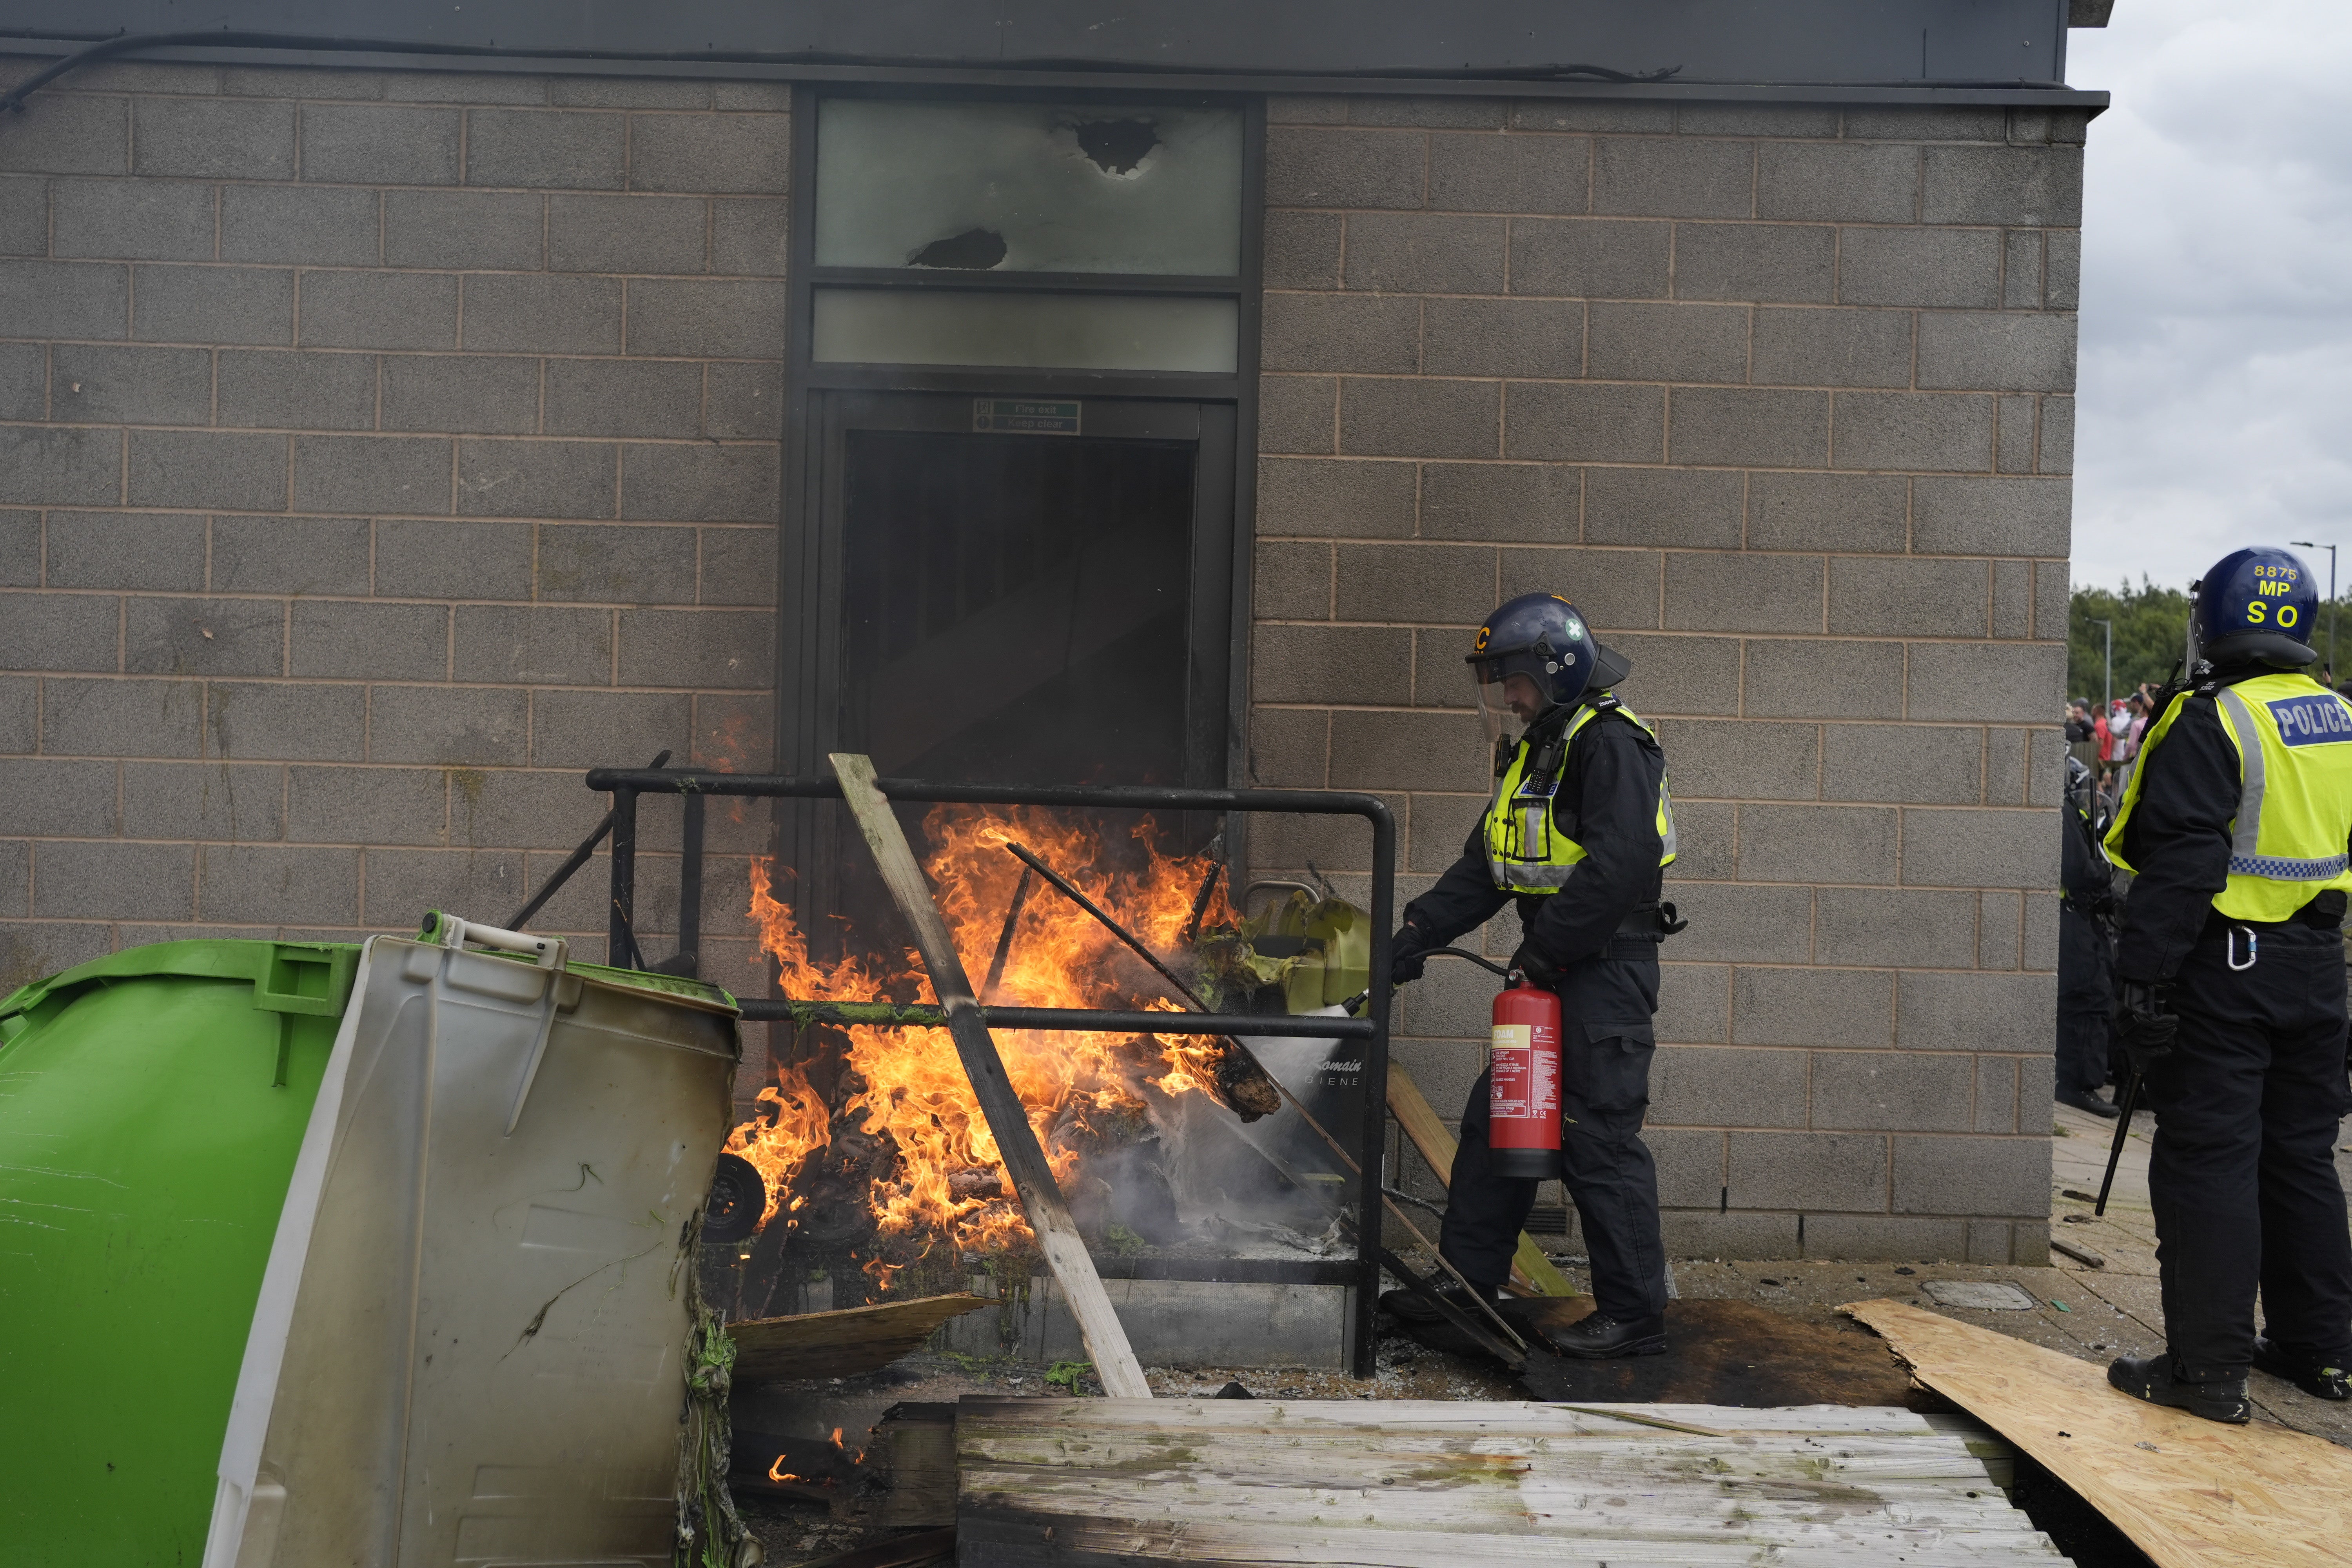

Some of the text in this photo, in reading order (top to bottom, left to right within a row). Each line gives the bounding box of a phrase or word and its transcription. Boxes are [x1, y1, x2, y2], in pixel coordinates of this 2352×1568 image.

[1016, 404, 1057, 414] Fire exit
[1008, 418, 1063, 429] Keep clear
[2254, 565, 2297, 580] 8875
[2259, 580, 2290, 597] MP
[2276, 703, 2352, 737] POLICE
[1494, 1029, 1514, 1039] FOAM
